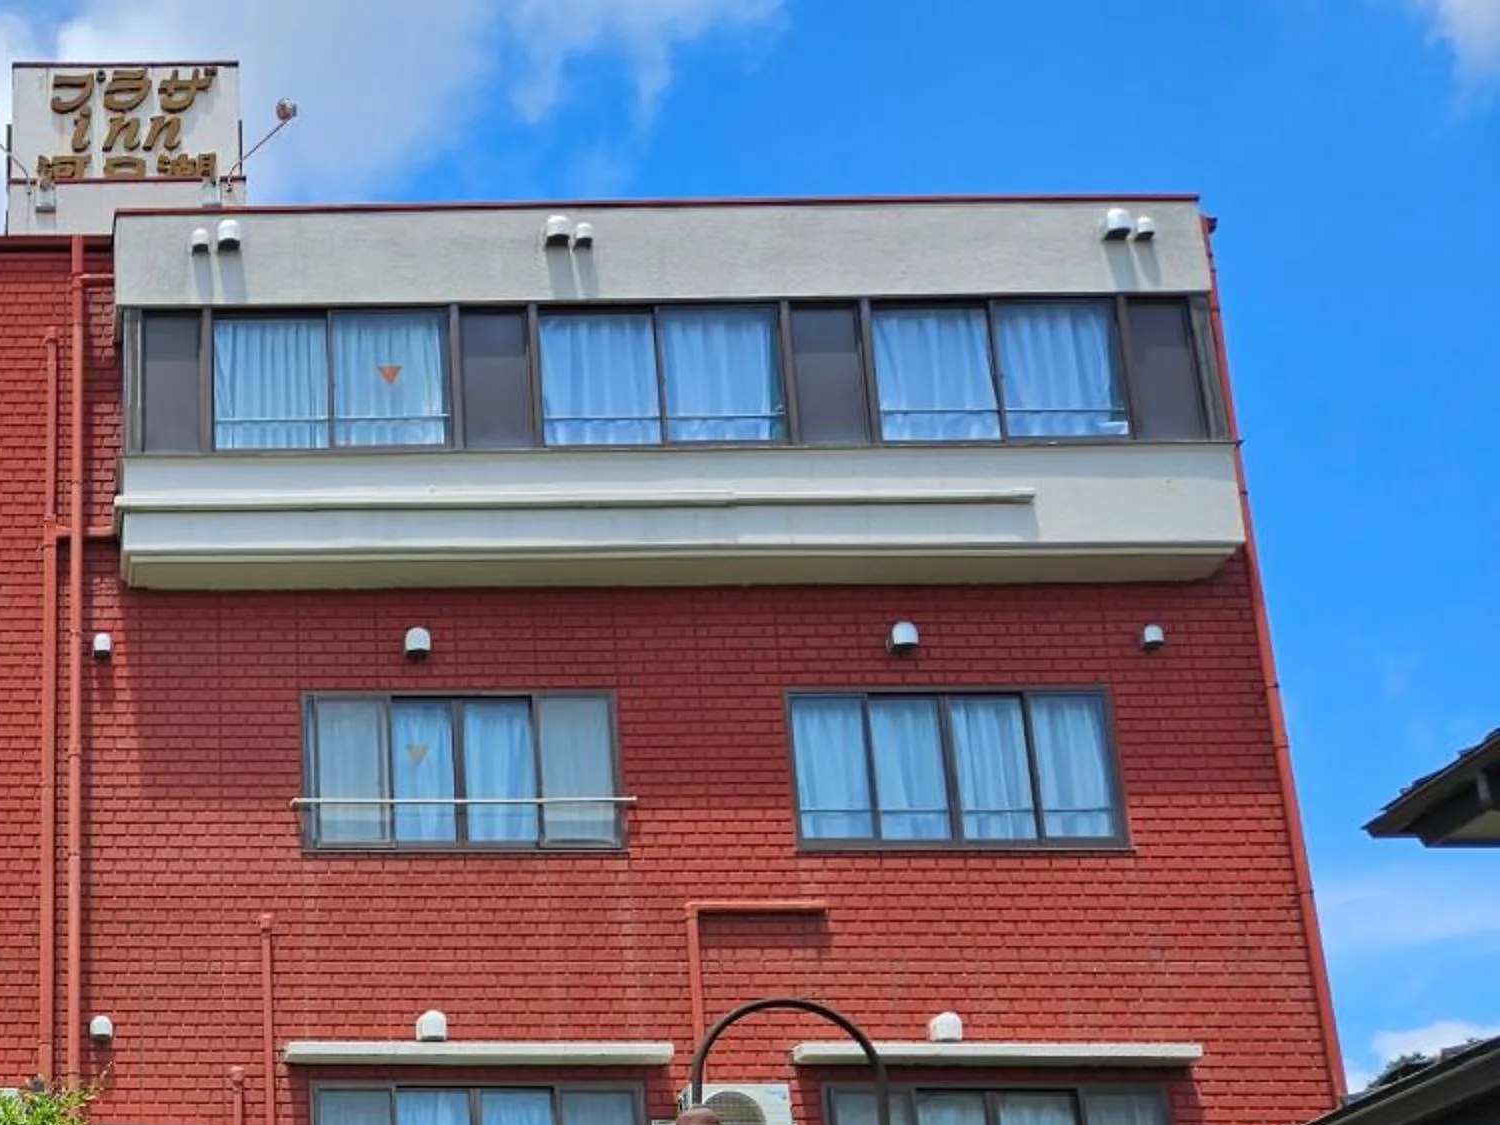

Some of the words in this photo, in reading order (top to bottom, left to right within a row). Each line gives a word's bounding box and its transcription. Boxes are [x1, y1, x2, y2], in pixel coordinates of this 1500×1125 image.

[50, 68, 217, 114] プラザ
[72, 105, 182, 152] inn
